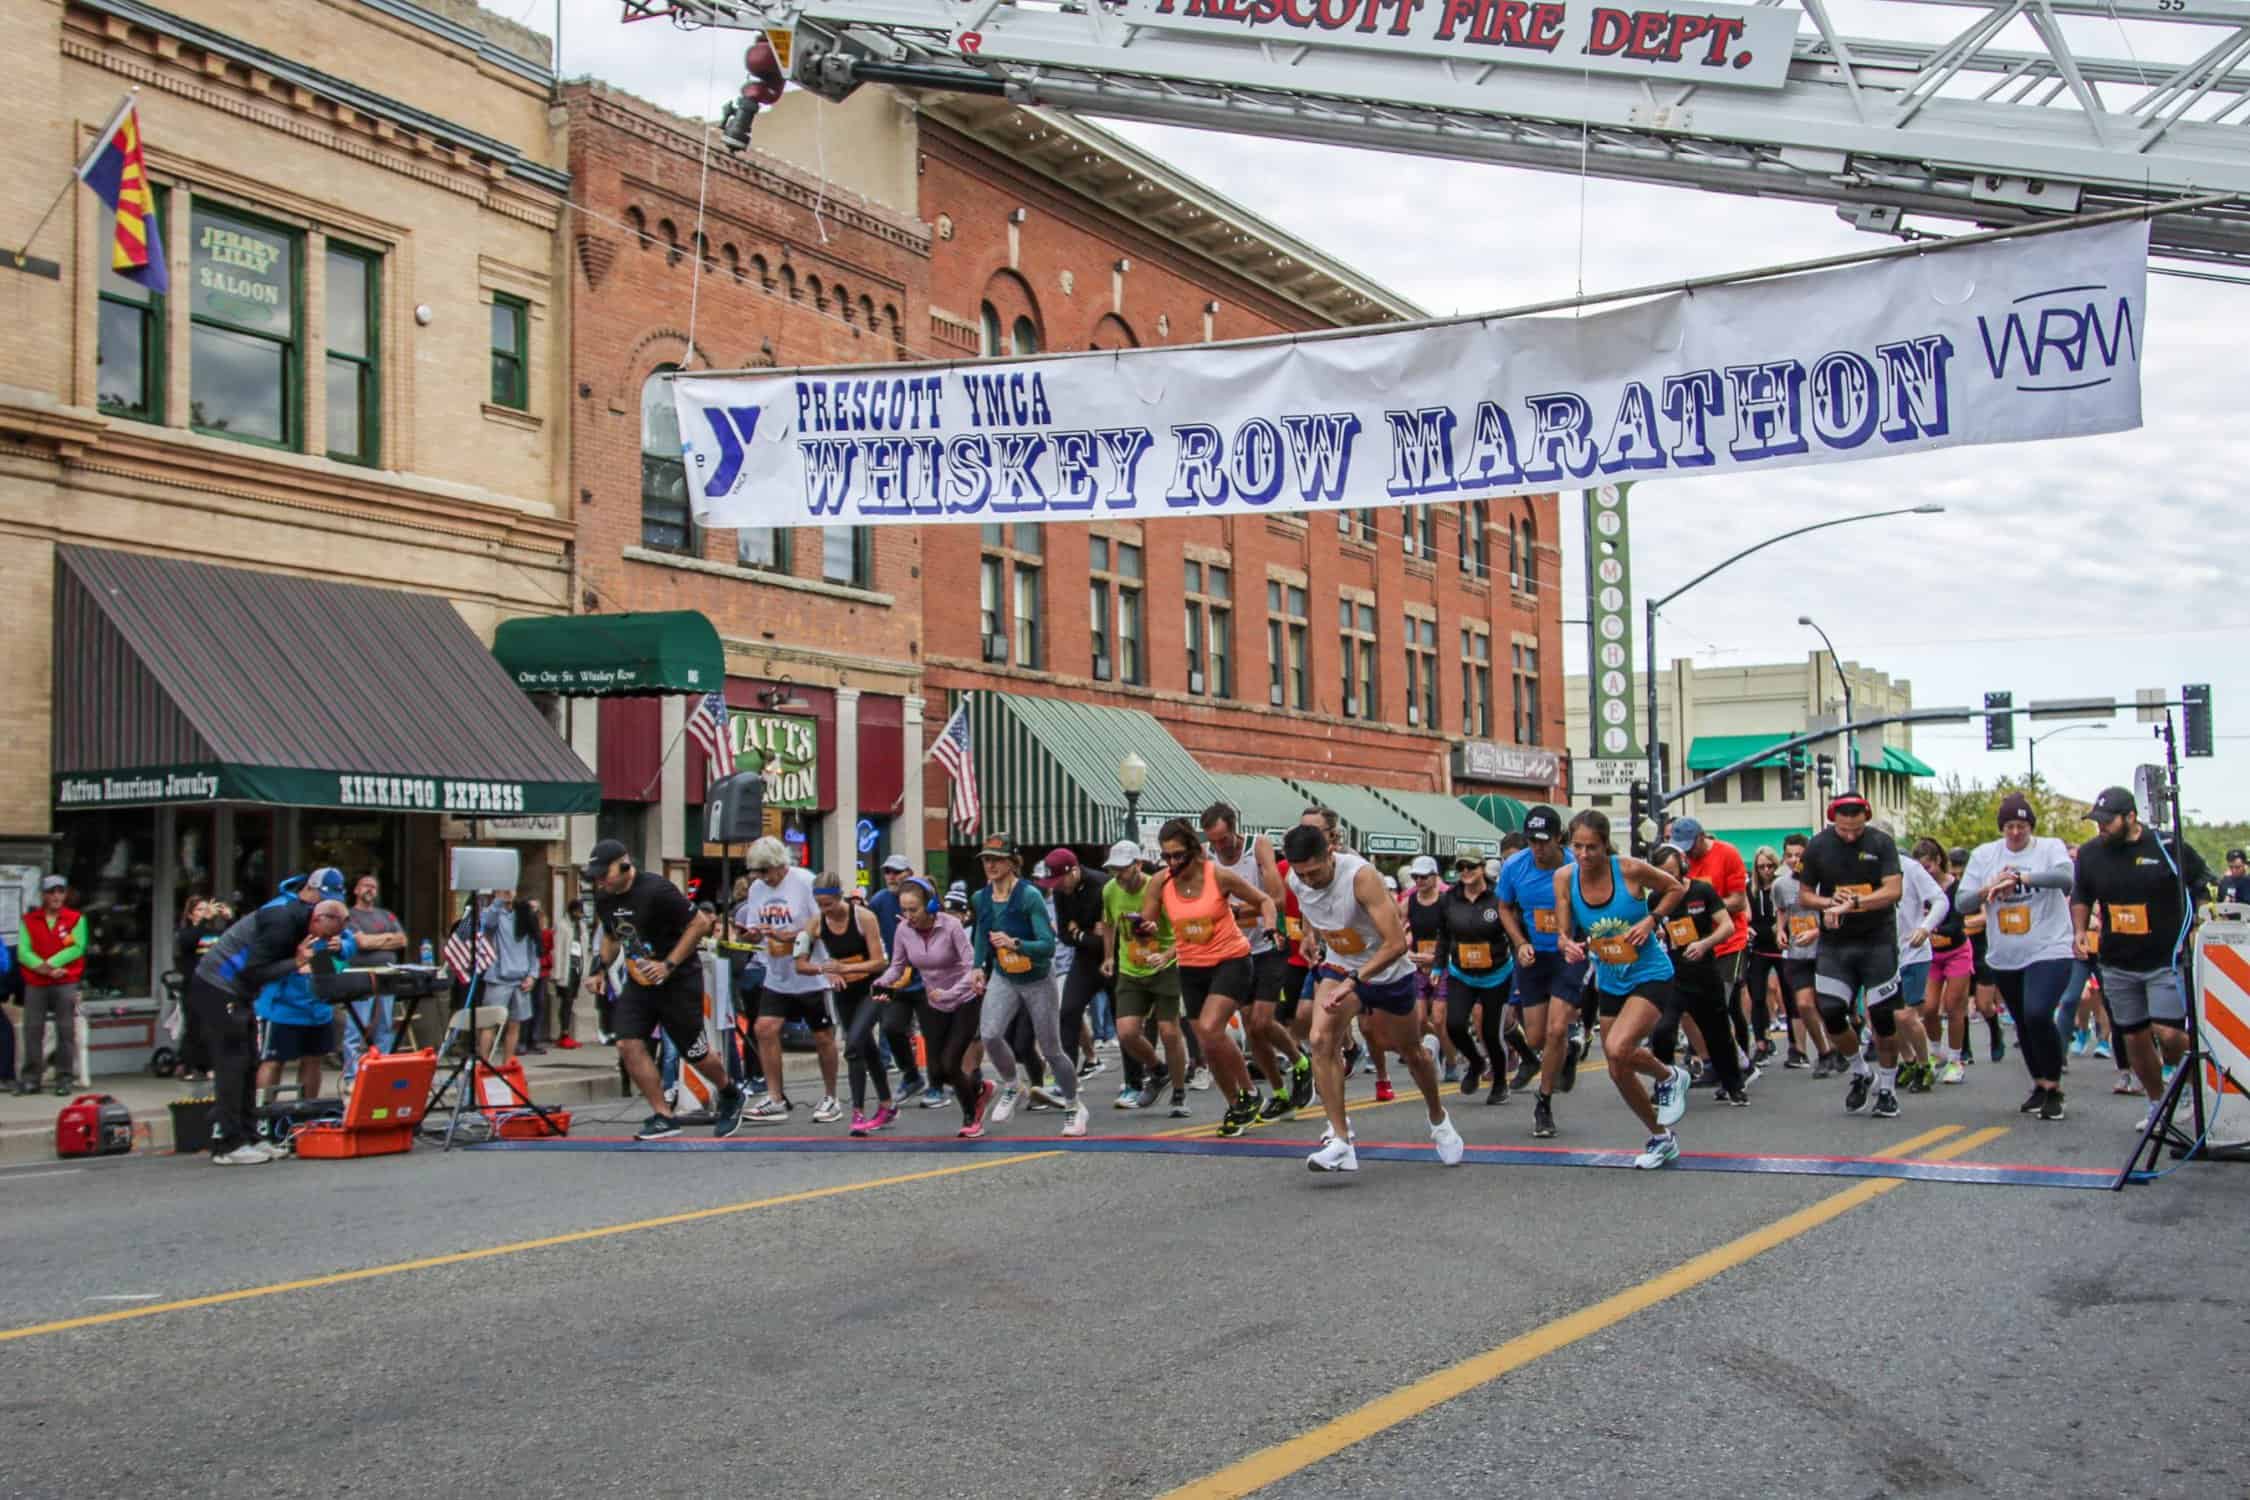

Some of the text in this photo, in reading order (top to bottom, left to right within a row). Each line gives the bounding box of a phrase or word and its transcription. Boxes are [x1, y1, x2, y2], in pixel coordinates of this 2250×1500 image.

[1155, 0, 1752, 69] SCOTT FIRE DEPT.
[200, 226, 281, 264] JERSEY
[212, 246, 270, 275] LILLY
[200, 266, 279, 304] SALOON
[1977, 296, 2136, 379] WRM
[795, 371, 1052, 432] PRESCOTT YMCA
[797, 334, 1955, 516] WHISKEY ROW MARATHON
[1602, 561, 1625, 750] MICHAEL
[580, 669, 615, 684] Whiskey
[617, 668, 637, 680] Row
[61, 771, 219, 802] Native American Jewelry
[339, 775, 524, 811] KIKKAPOO EXPRESS
[762, 767, 817, 803] OON
